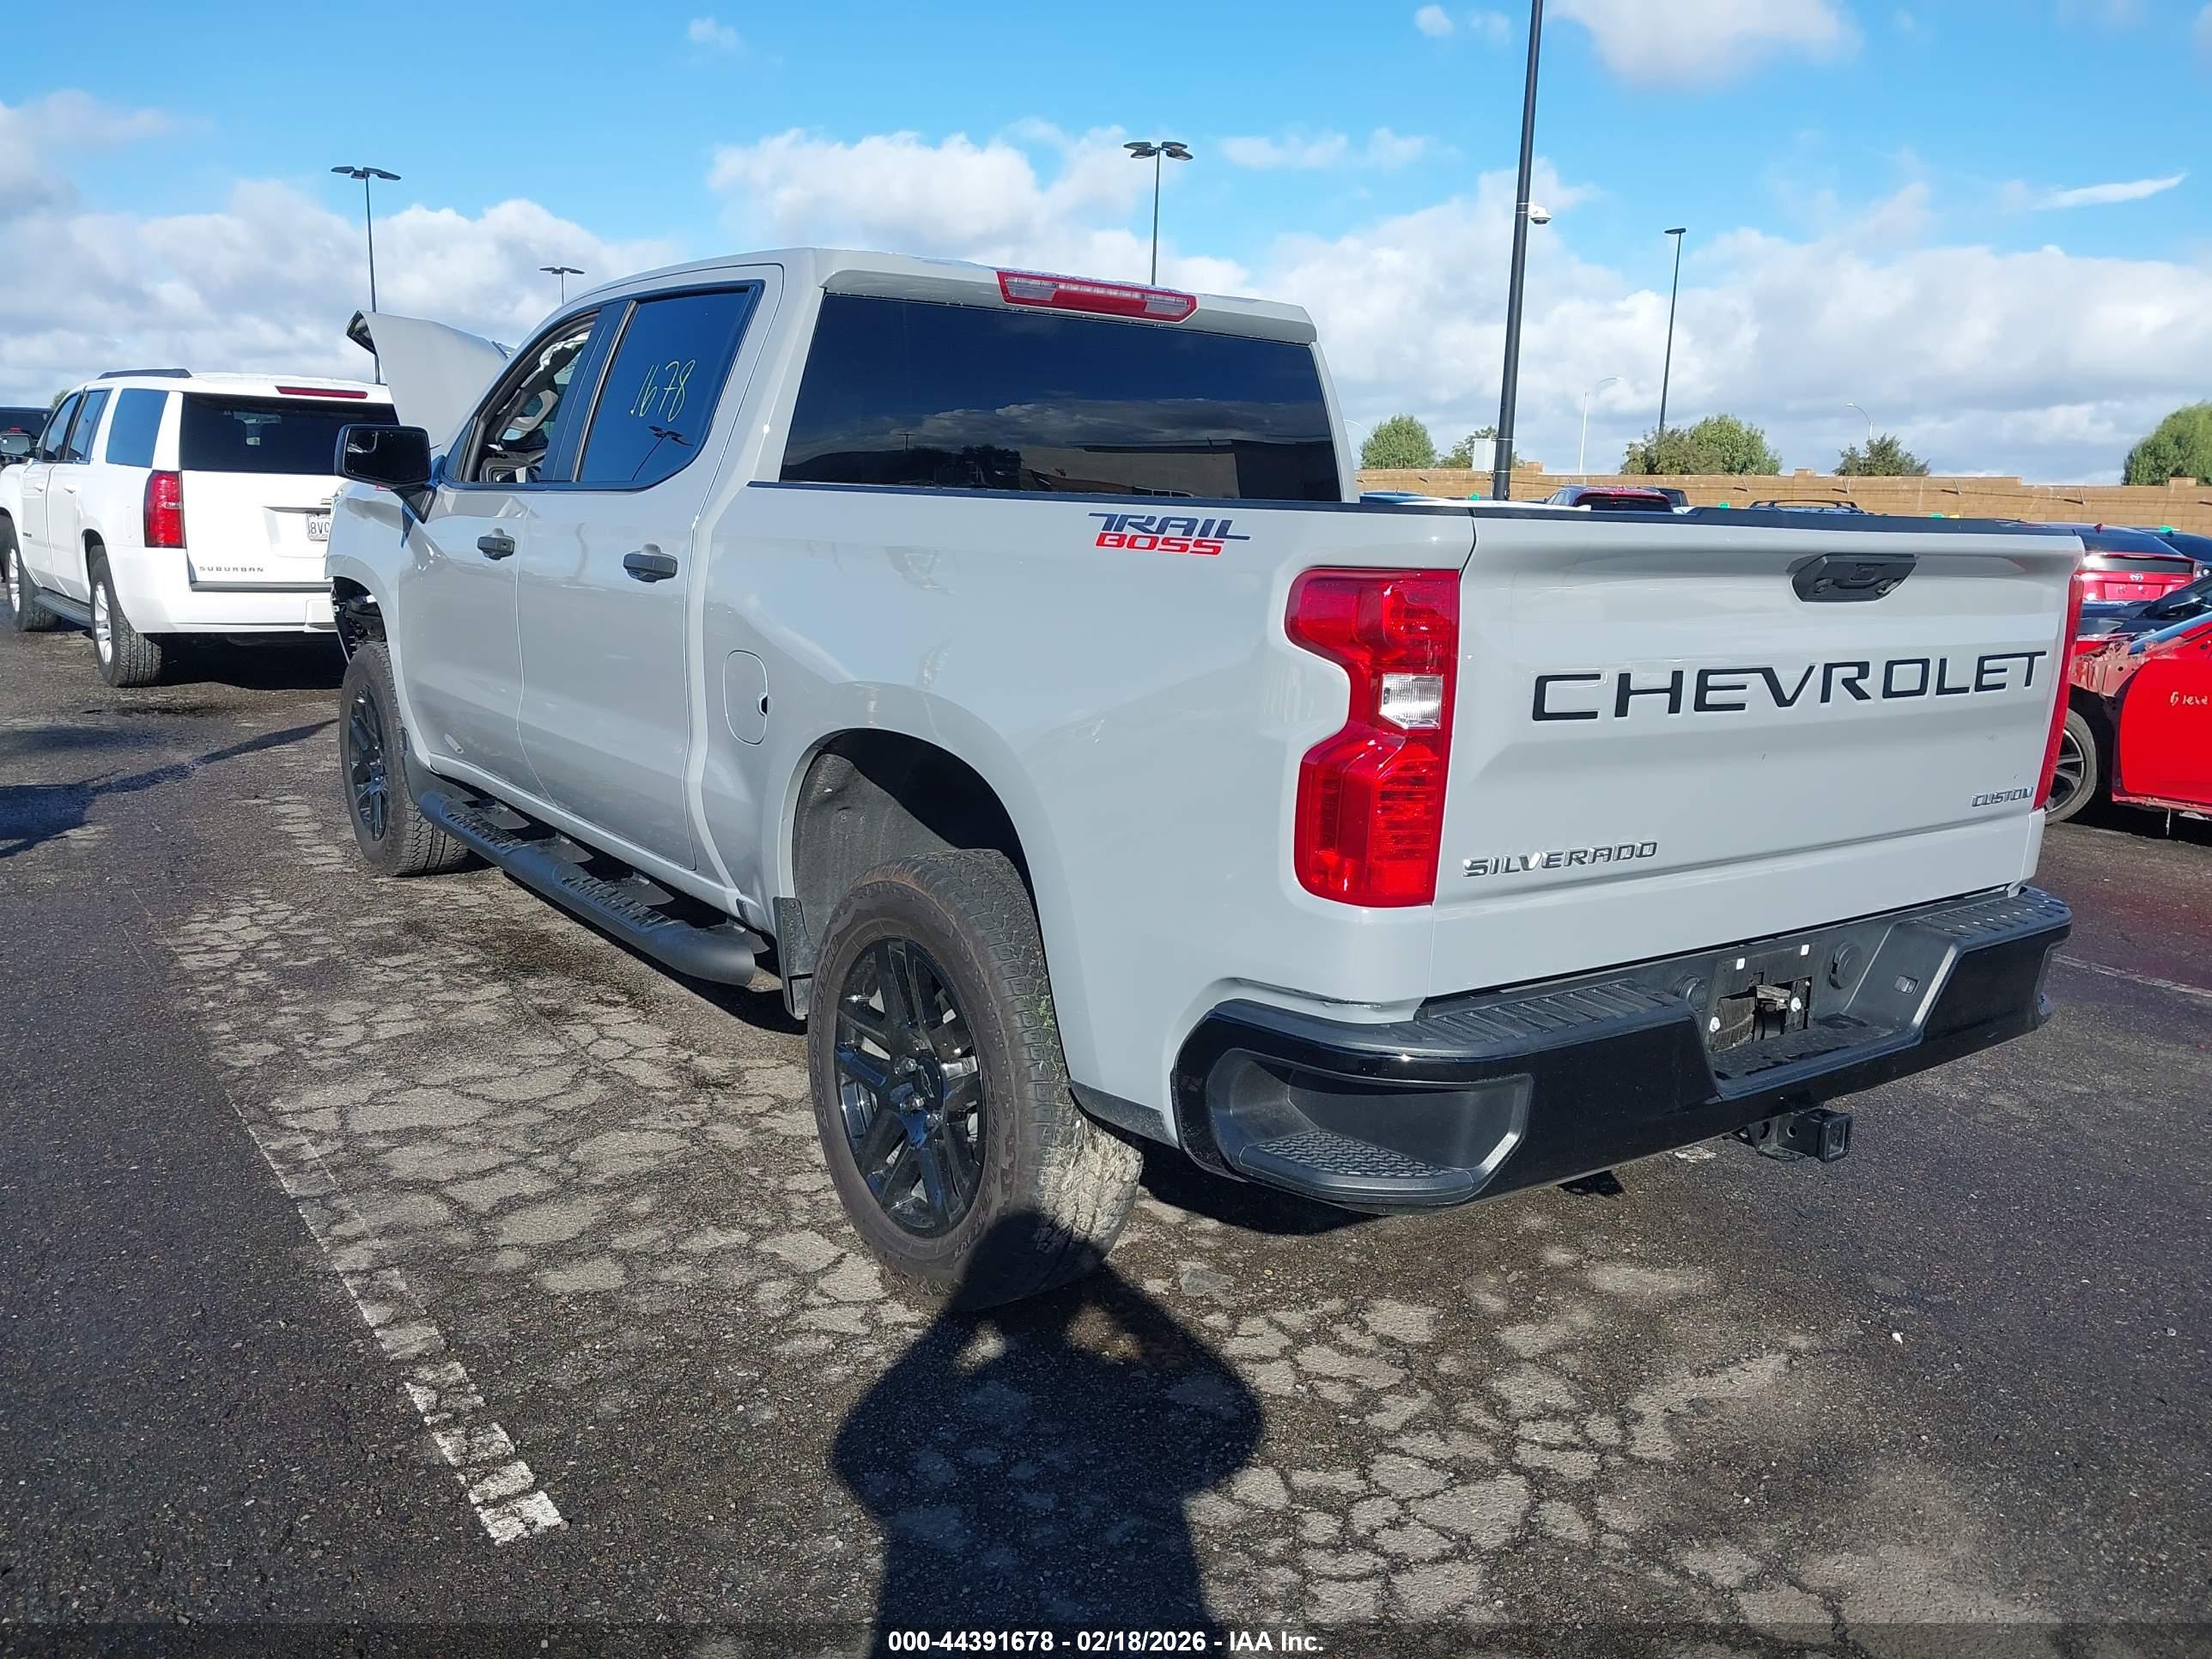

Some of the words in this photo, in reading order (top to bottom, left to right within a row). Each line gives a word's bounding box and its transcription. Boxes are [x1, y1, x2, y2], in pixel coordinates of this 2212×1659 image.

[630, 359, 696, 422] 1678
[1088, 512, 1251, 541] TRAIL
[1095, 532, 1225, 556] BOSS
[1532, 651, 2047, 721] CHEVROLET
[1972, 787, 2034, 807] CUSTOM
[1462, 841, 1658, 878] SILVERADO
